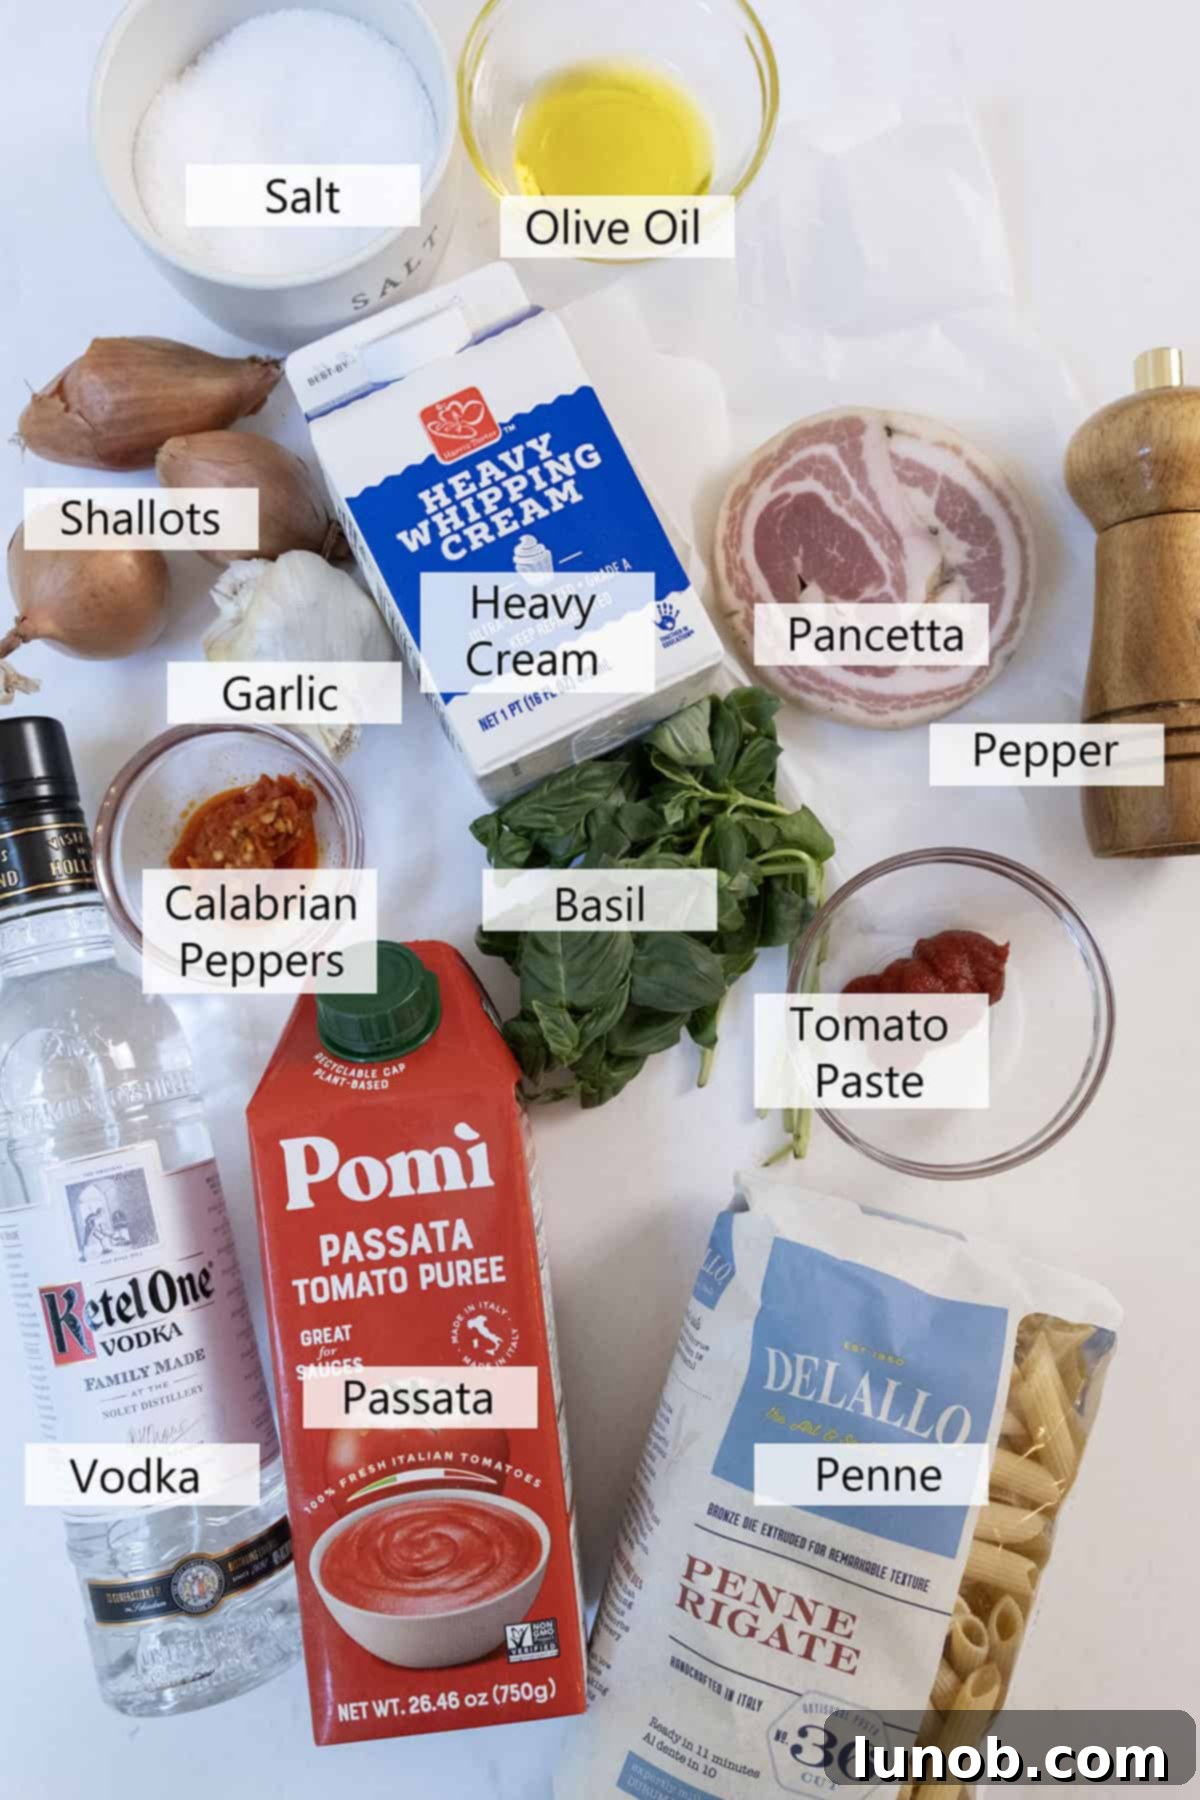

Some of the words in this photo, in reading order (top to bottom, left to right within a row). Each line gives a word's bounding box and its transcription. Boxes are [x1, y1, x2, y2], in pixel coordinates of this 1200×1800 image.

[351, 223, 438, 311] SALT
[396, 443, 602, 553] WHIPPING
[418, 433, 552, 515] HEAVY
[441, 478, 584, 561] CREAM
[478, 712, 500, 732] NET
[500, 708, 509, 722] 1
[509, 700, 525, 717] PT
[524, 691, 543, 713] (16
[312, 1067, 390, 1091] PLANT-BASED
[313, 1051, 379, 1079] RECYCLABLE
[383, 1062, 406, 1077] CAP
[319, 1217, 474, 1267] PASSATA
[292, 1265, 408, 1306] TOMATO
[418, 1255, 506, 1291] PUREE
[42, 1276, 148, 1357] Ketel
[148, 1264, 216, 1315] One
[479, 1300, 509, 1316] ITALY
[100, 1321, 184, 1357] VODKA
[300, 1324, 353, 1347] GREAT
[316, 1345, 338, 1361] for
[84, 1365, 151, 1392] FAMILY
[153, 1348, 206, 1375] MADE
[130, 1389, 145, 1398] AT
[148, 1381, 170, 1393] THE
[295, 1356, 365, 1381] SAUCES
[101, 1403, 138, 1420] NOLET
[140, 1384, 205, 1412] DISTILLERY
[762, 1346, 972, 1446] DELALLO
[303, 1487, 336, 1515] 100%
[339, 1461, 387, 1489] FRESH
[391, 1451, 454, 1468] ITALIAN
[460, 1452, 542, 1489] TOMATOES
[706, 1501, 742, 1527] BRONZE
[742, 1515, 758, 1533] DIE
[760, 1522, 807, 1549] EXTRUDED
[808, 1540, 827, 1558] FOR
[828, 1547, 888, 1580] REMARKABLE
[890, 1569, 931, 1593] TEXTURE
[681, 1553, 856, 1640] PENNE
[675, 1582, 862, 1676] RIGATE
[337, 1701, 369, 1723] NET
[372, 1697, 405, 1719] WT.
[409, 1691, 460, 1714] 26.46
[464, 1692, 489, 1709] oz
[492, 1677, 557, 1705] (750g)
[669, 1655, 723, 1696] HANDCRAFTED
[724, 1687, 735, 1703] IN
[736, 1692, 764, 1713] ITALY
[642, 1732, 656, 1747] Al
[656, 1740, 687, 1764] dente
[686, 1757, 700, 1771] in
[703, 1764, 718, 1779] 10
[648, 1716, 682, 1745] Ready
[682, 1738, 695, 1752] in
[696, 1745, 709, 1760] 11
[711, 1755, 761, 1779] minutes
[801, 1771, 839, 1792] CUT
